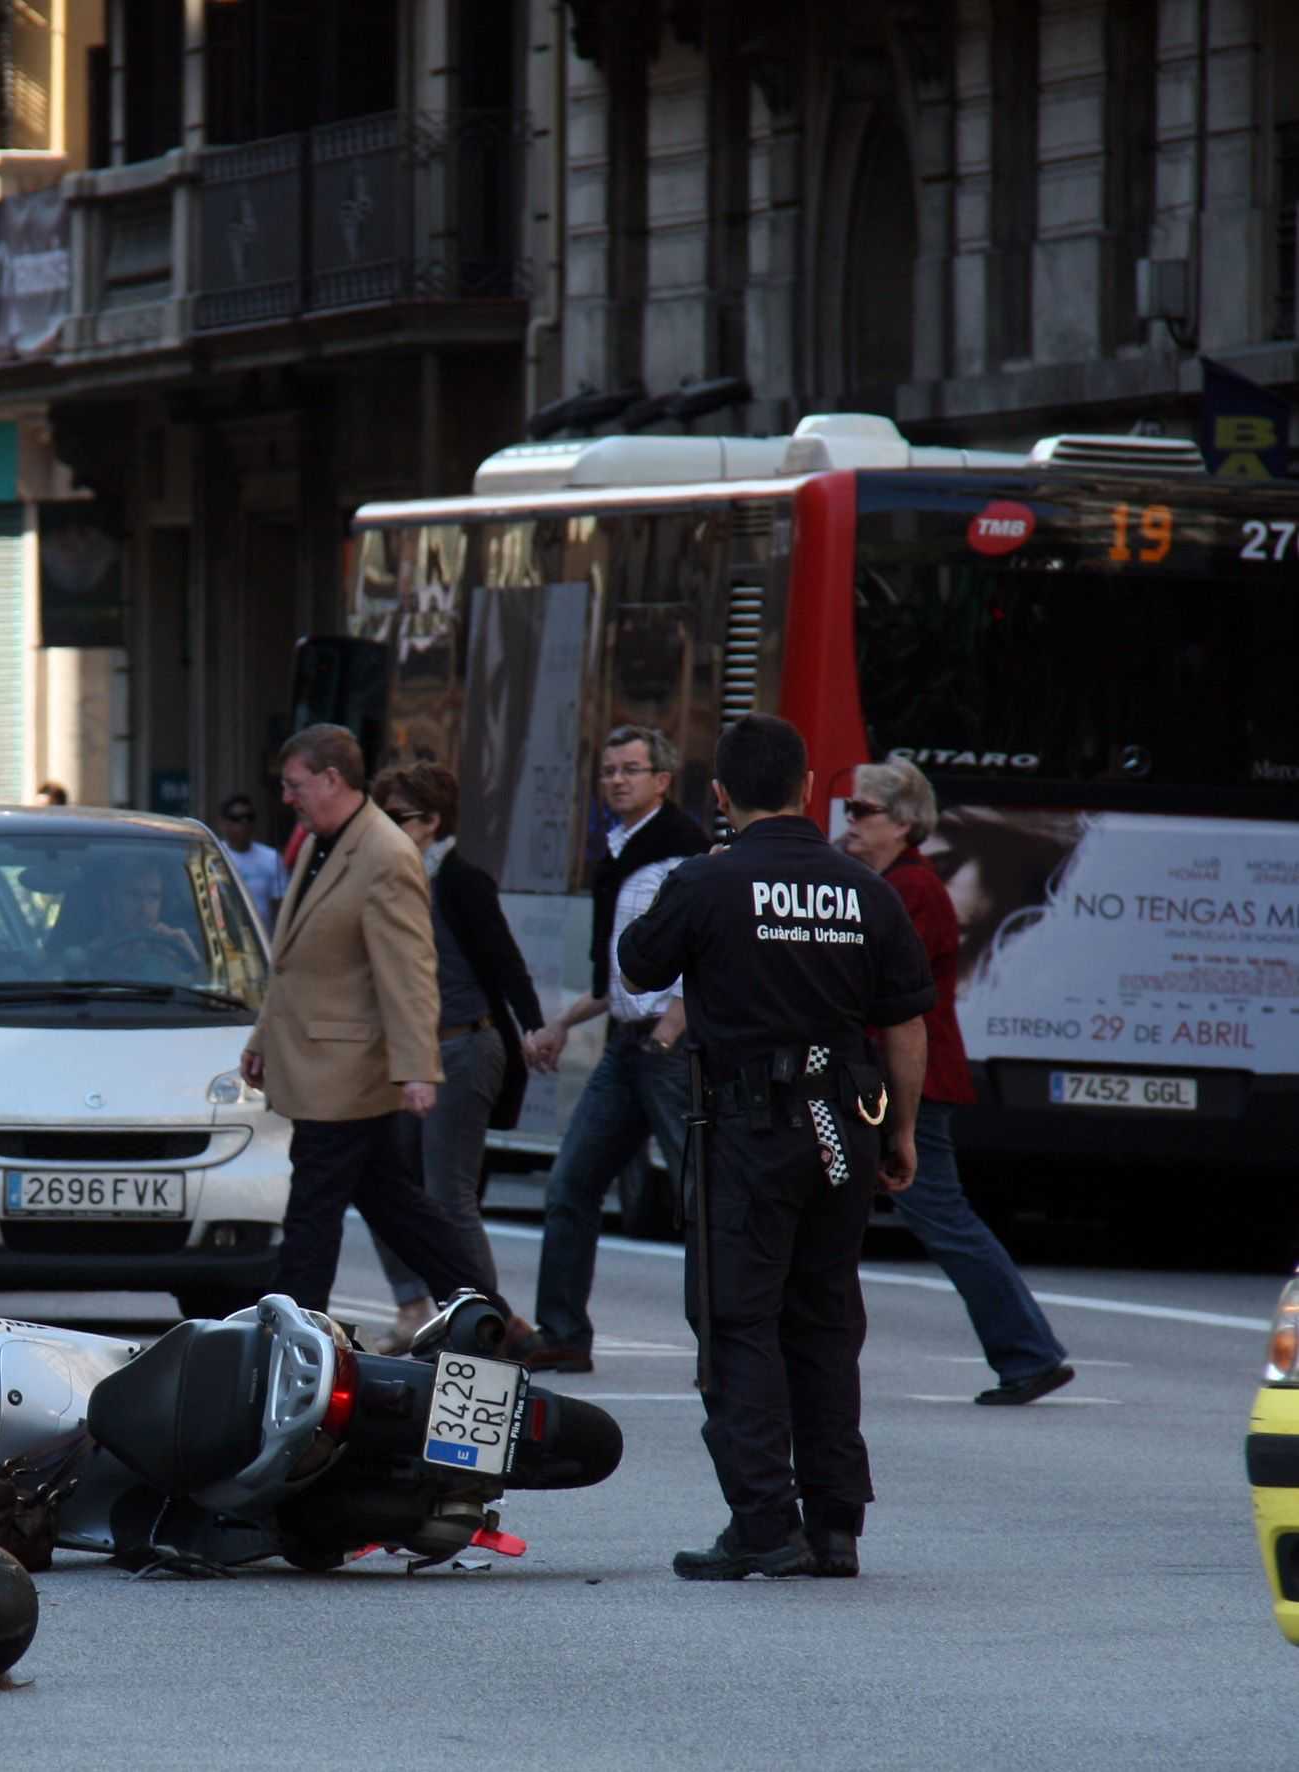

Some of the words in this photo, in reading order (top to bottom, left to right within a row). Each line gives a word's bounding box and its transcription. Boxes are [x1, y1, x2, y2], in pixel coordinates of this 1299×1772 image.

[977, 518, 1027, 538] TMB
[1109, 502, 1173, 562] 19
[1240, 518, 1299, 562] 27
[752, 881, 862, 923] POLICIA
[1074, 893, 1124, 921] NO
[1134, 895, 1256, 928] TENGAS
[1266, 903, 1299, 929] M
[814, 927, 865, 945] Urbana
[986, 1016, 1082, 1041] ESTRENO
[1090, 1014, 1126, 1042] 29
[1134, 1023, 1162, 1044] DE
[1171, 1020, 1256, 1050] ABRIL
[1068, 1076, 1132, 1101] 7452
[1143, 1080, 1191, 1106] GGL
[27, 1177, 105, 1206] 2696
[112, 1178, 169, 1207] FVK
[435, 1361, 477, 1440] 3428
[470, 1390, 509, 1446] CRL
[456, 1449, 470, 1461] E
